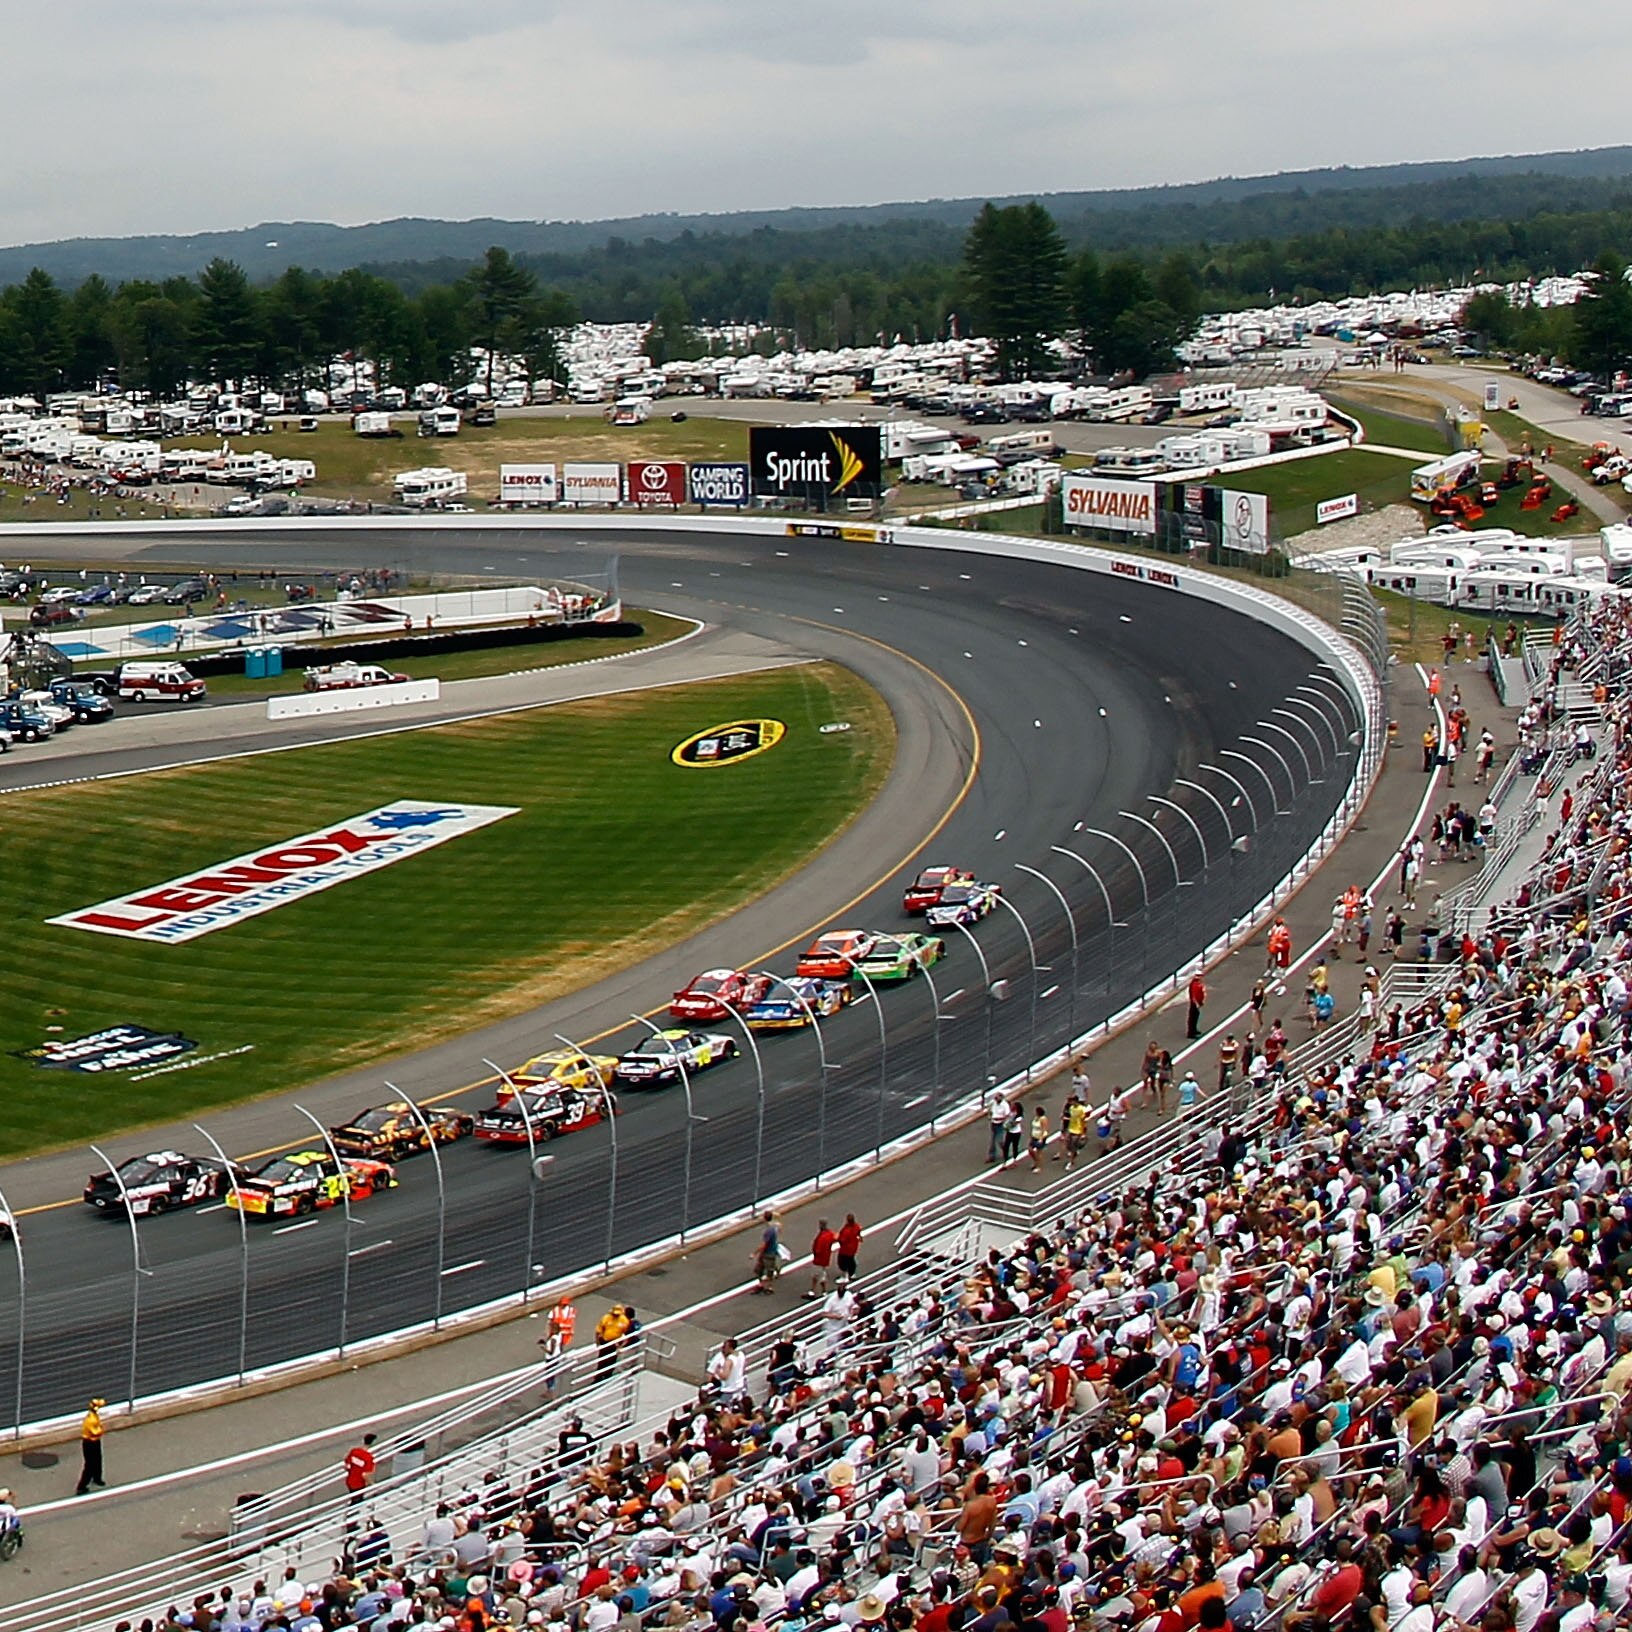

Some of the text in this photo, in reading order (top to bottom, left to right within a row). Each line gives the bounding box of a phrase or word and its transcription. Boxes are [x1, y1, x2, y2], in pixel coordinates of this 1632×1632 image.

[503, 475, 542, 485] LENOX
[691, 467, 743, 482] CAMPING
[766, 451, 831, 490] Sprint
[566, 476, 618, 488] SYLVANIA
[692, 482, 743, 499] WORLD
[638, 491, 672, 501] TOYOTA
[1068, 487, 1150, 520] SYLVANIA
[1319, 501, 1348, 515] LENOX
[72, 827, 400, 932] LENOX
[146, 832, 435, 939] INDUSTRIAL TOOLS
[565, 1101, 586, 1125] 39
[182, 1175, 209, 1201] 36
